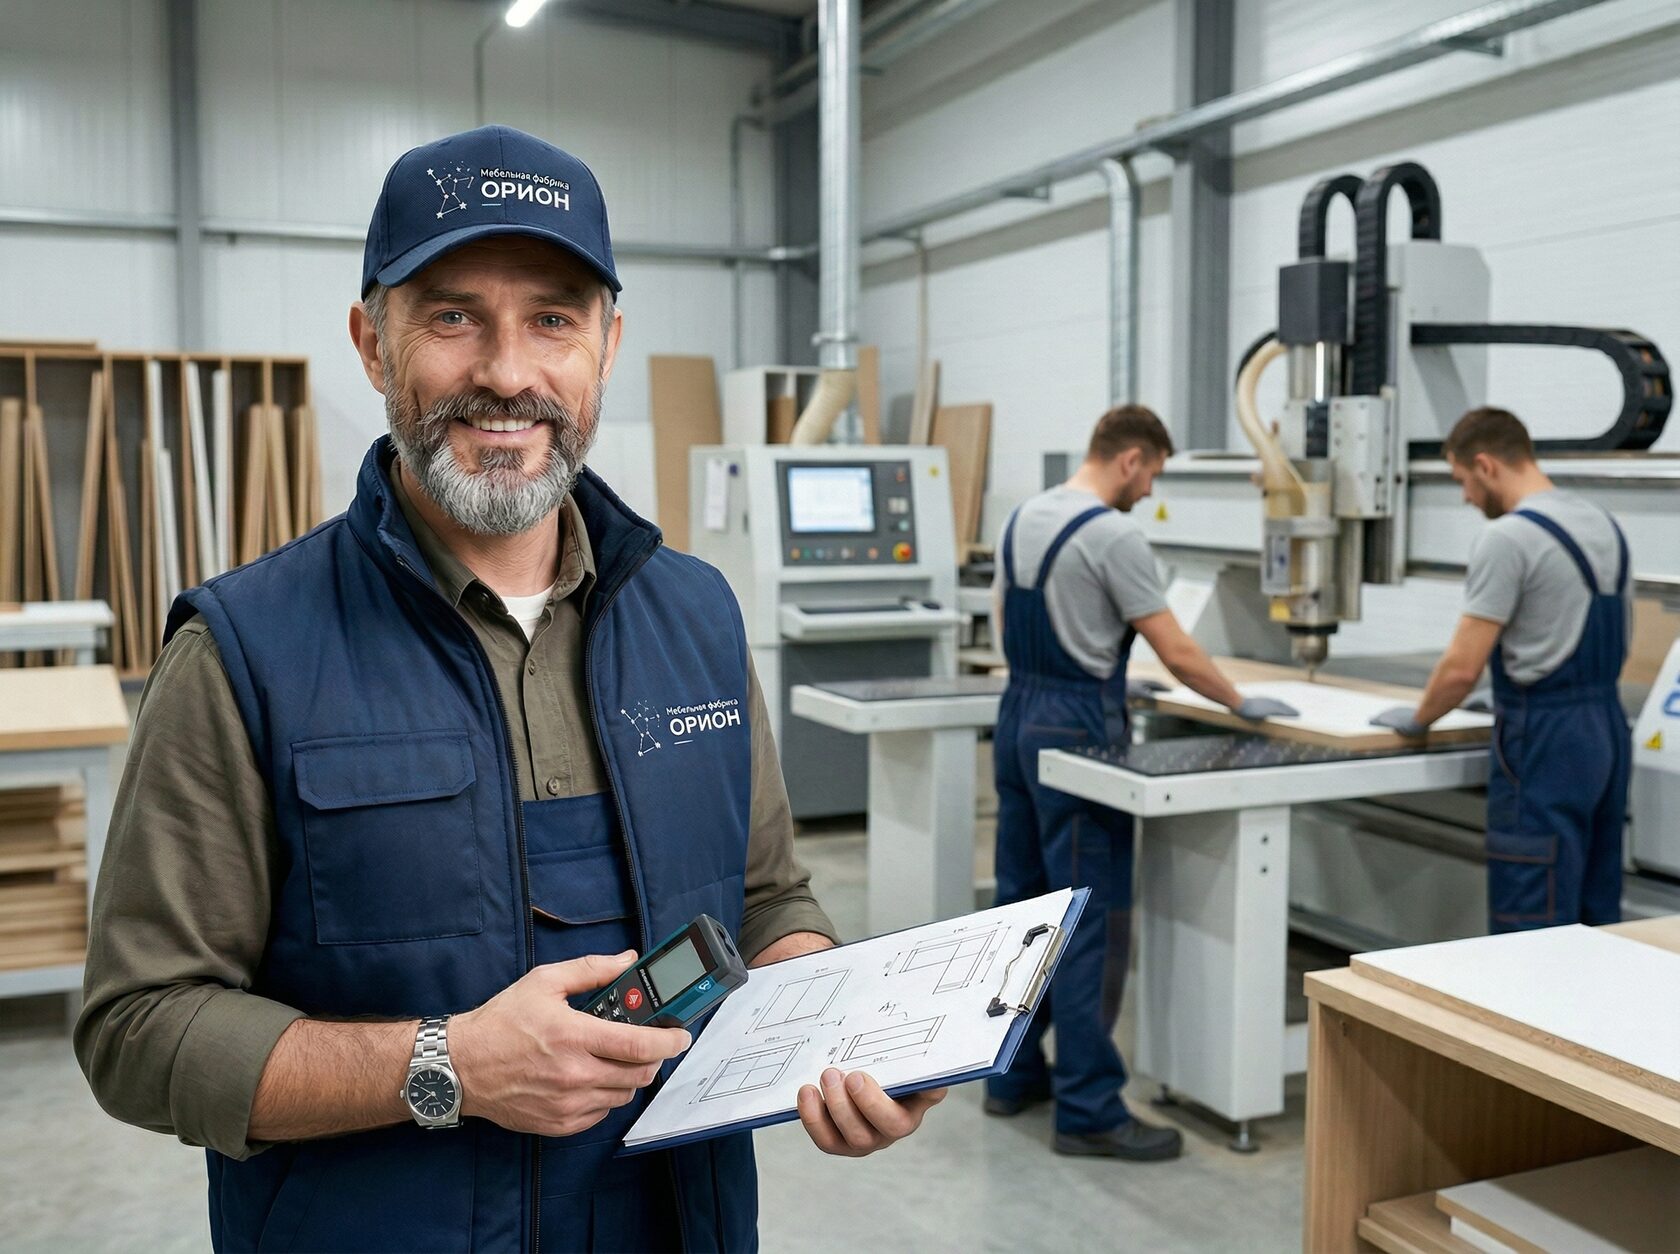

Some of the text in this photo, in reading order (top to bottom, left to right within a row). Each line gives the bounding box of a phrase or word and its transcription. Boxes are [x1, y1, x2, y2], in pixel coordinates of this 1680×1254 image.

[480, 168, 570, 191] Мебельная фабрика
[481, 181, 570, 211] ОРИОН
[669, 708, 741, 736] ОРИОН
